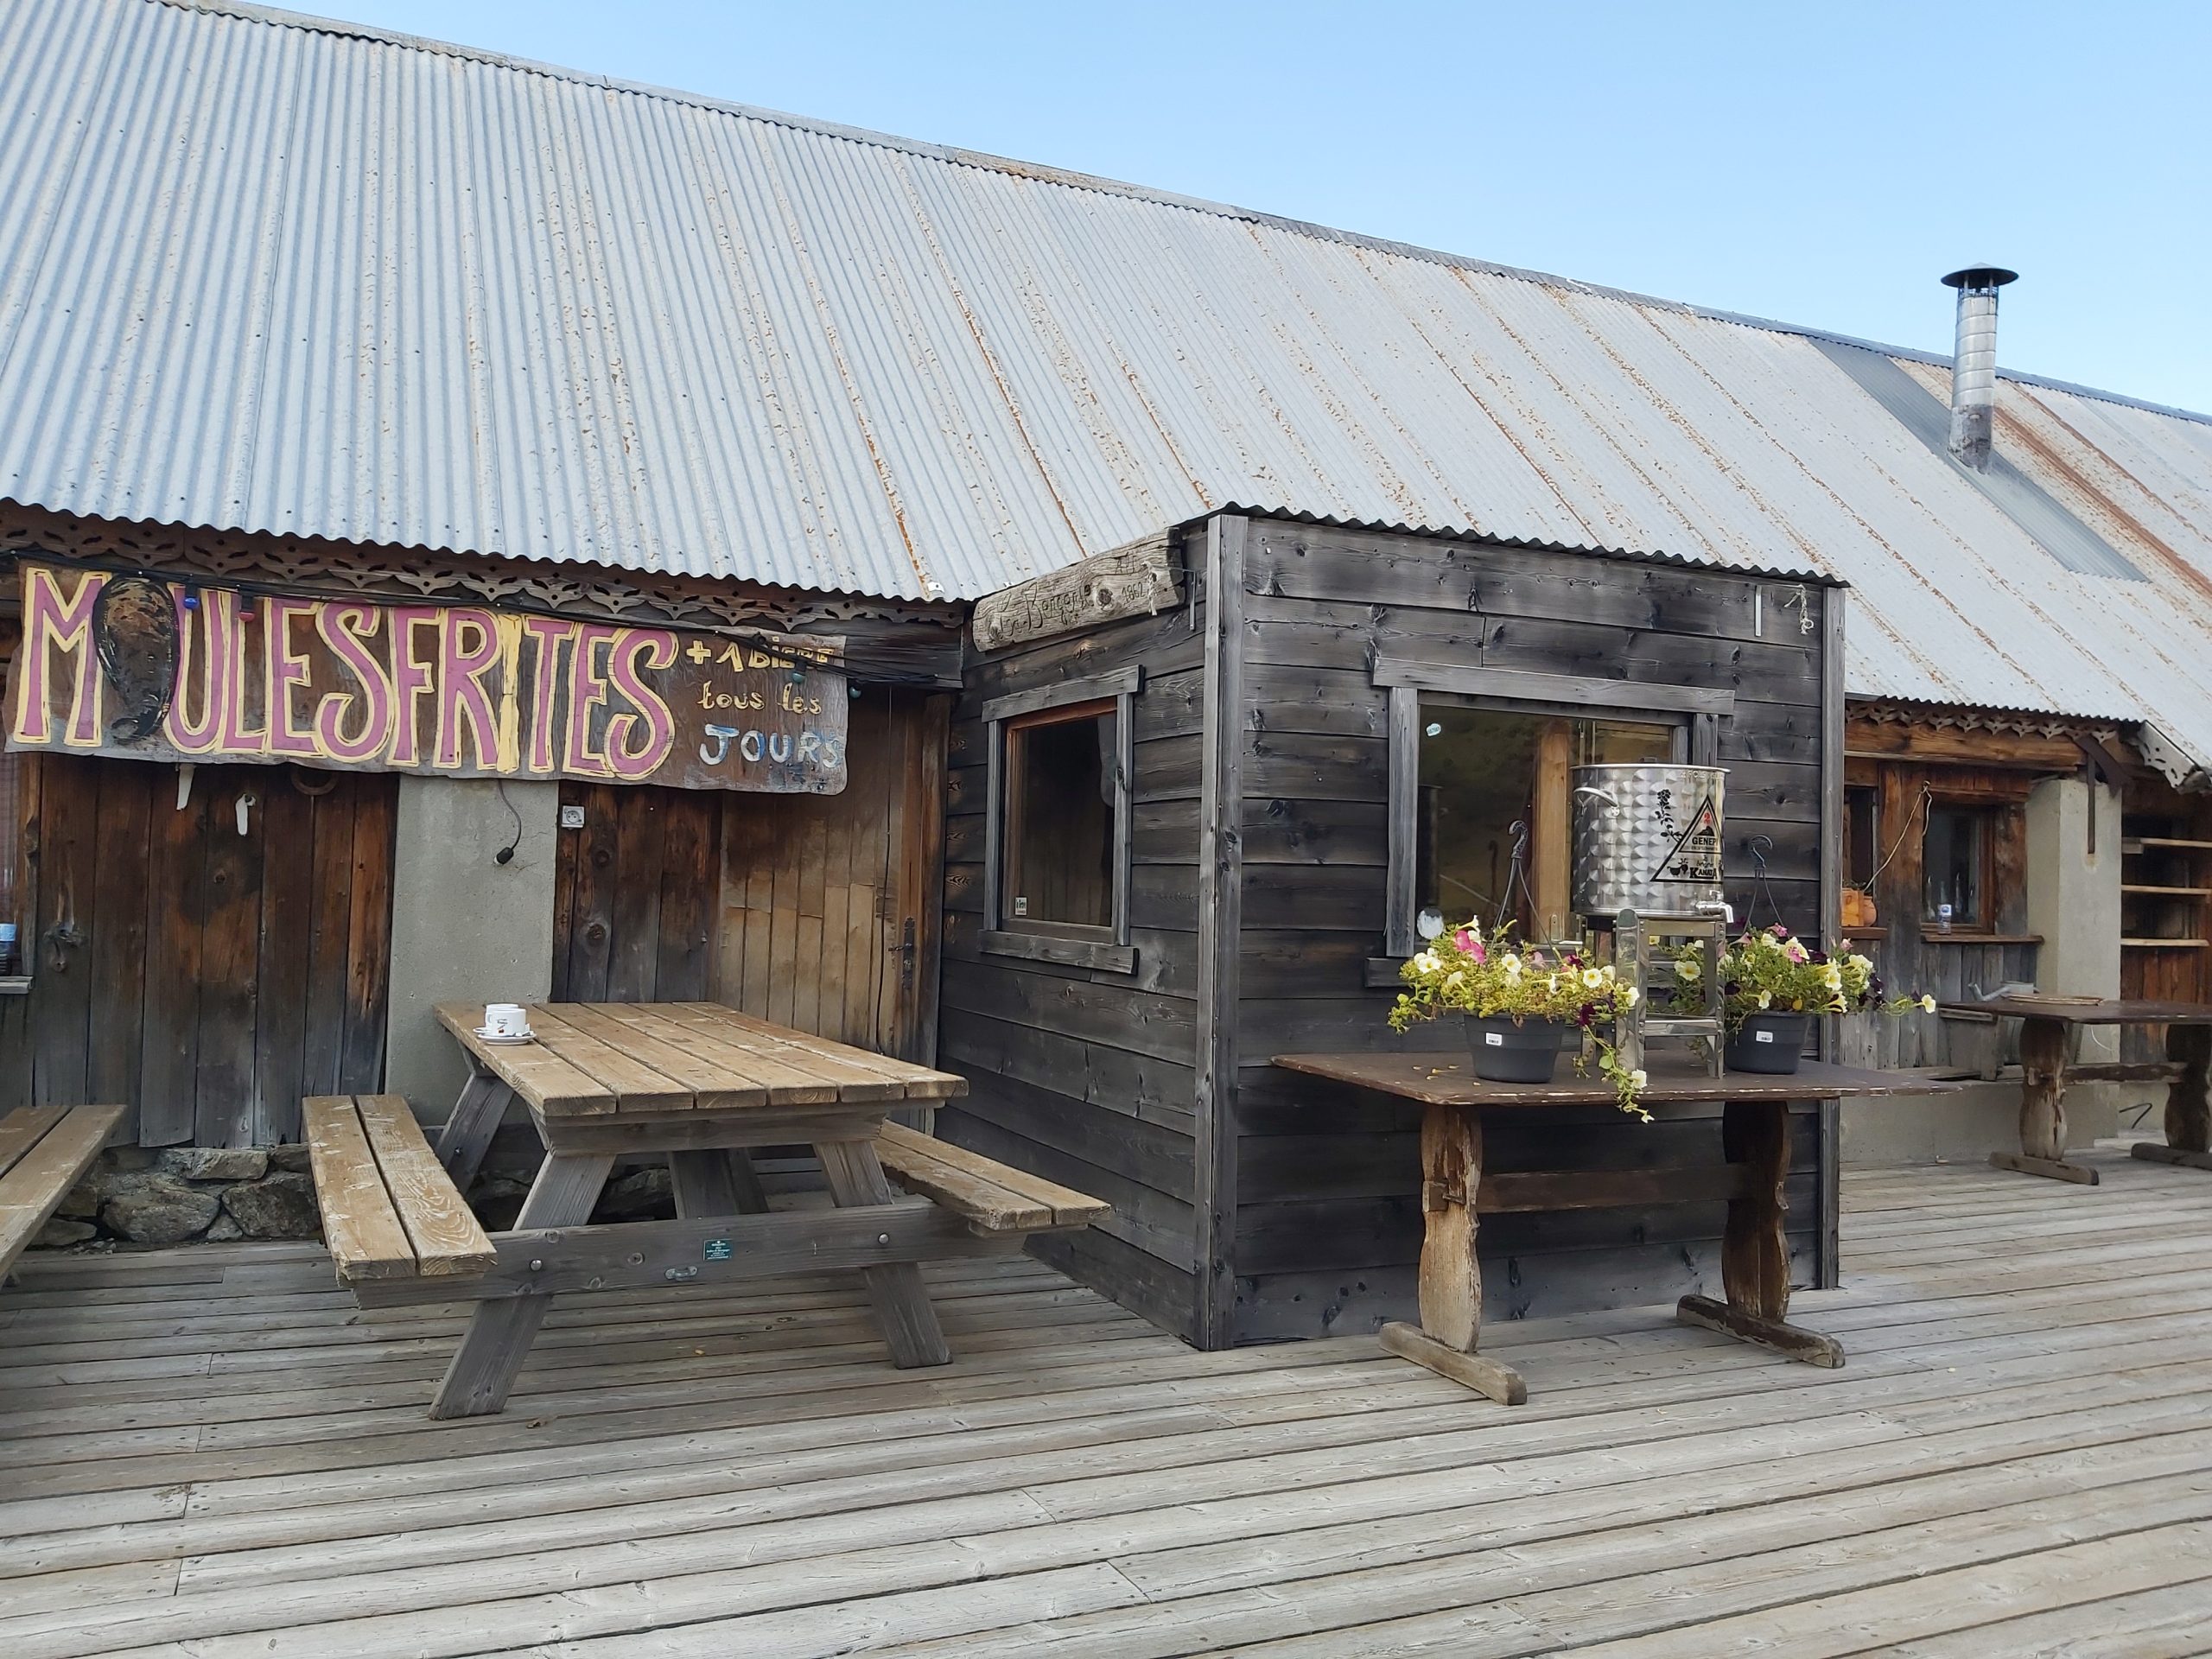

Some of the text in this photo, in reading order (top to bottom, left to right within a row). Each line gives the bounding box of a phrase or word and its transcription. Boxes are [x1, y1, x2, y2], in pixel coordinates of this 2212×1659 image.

[698, 680, 823, 715] tous les
[699, 723, 845, 768] JOURS
